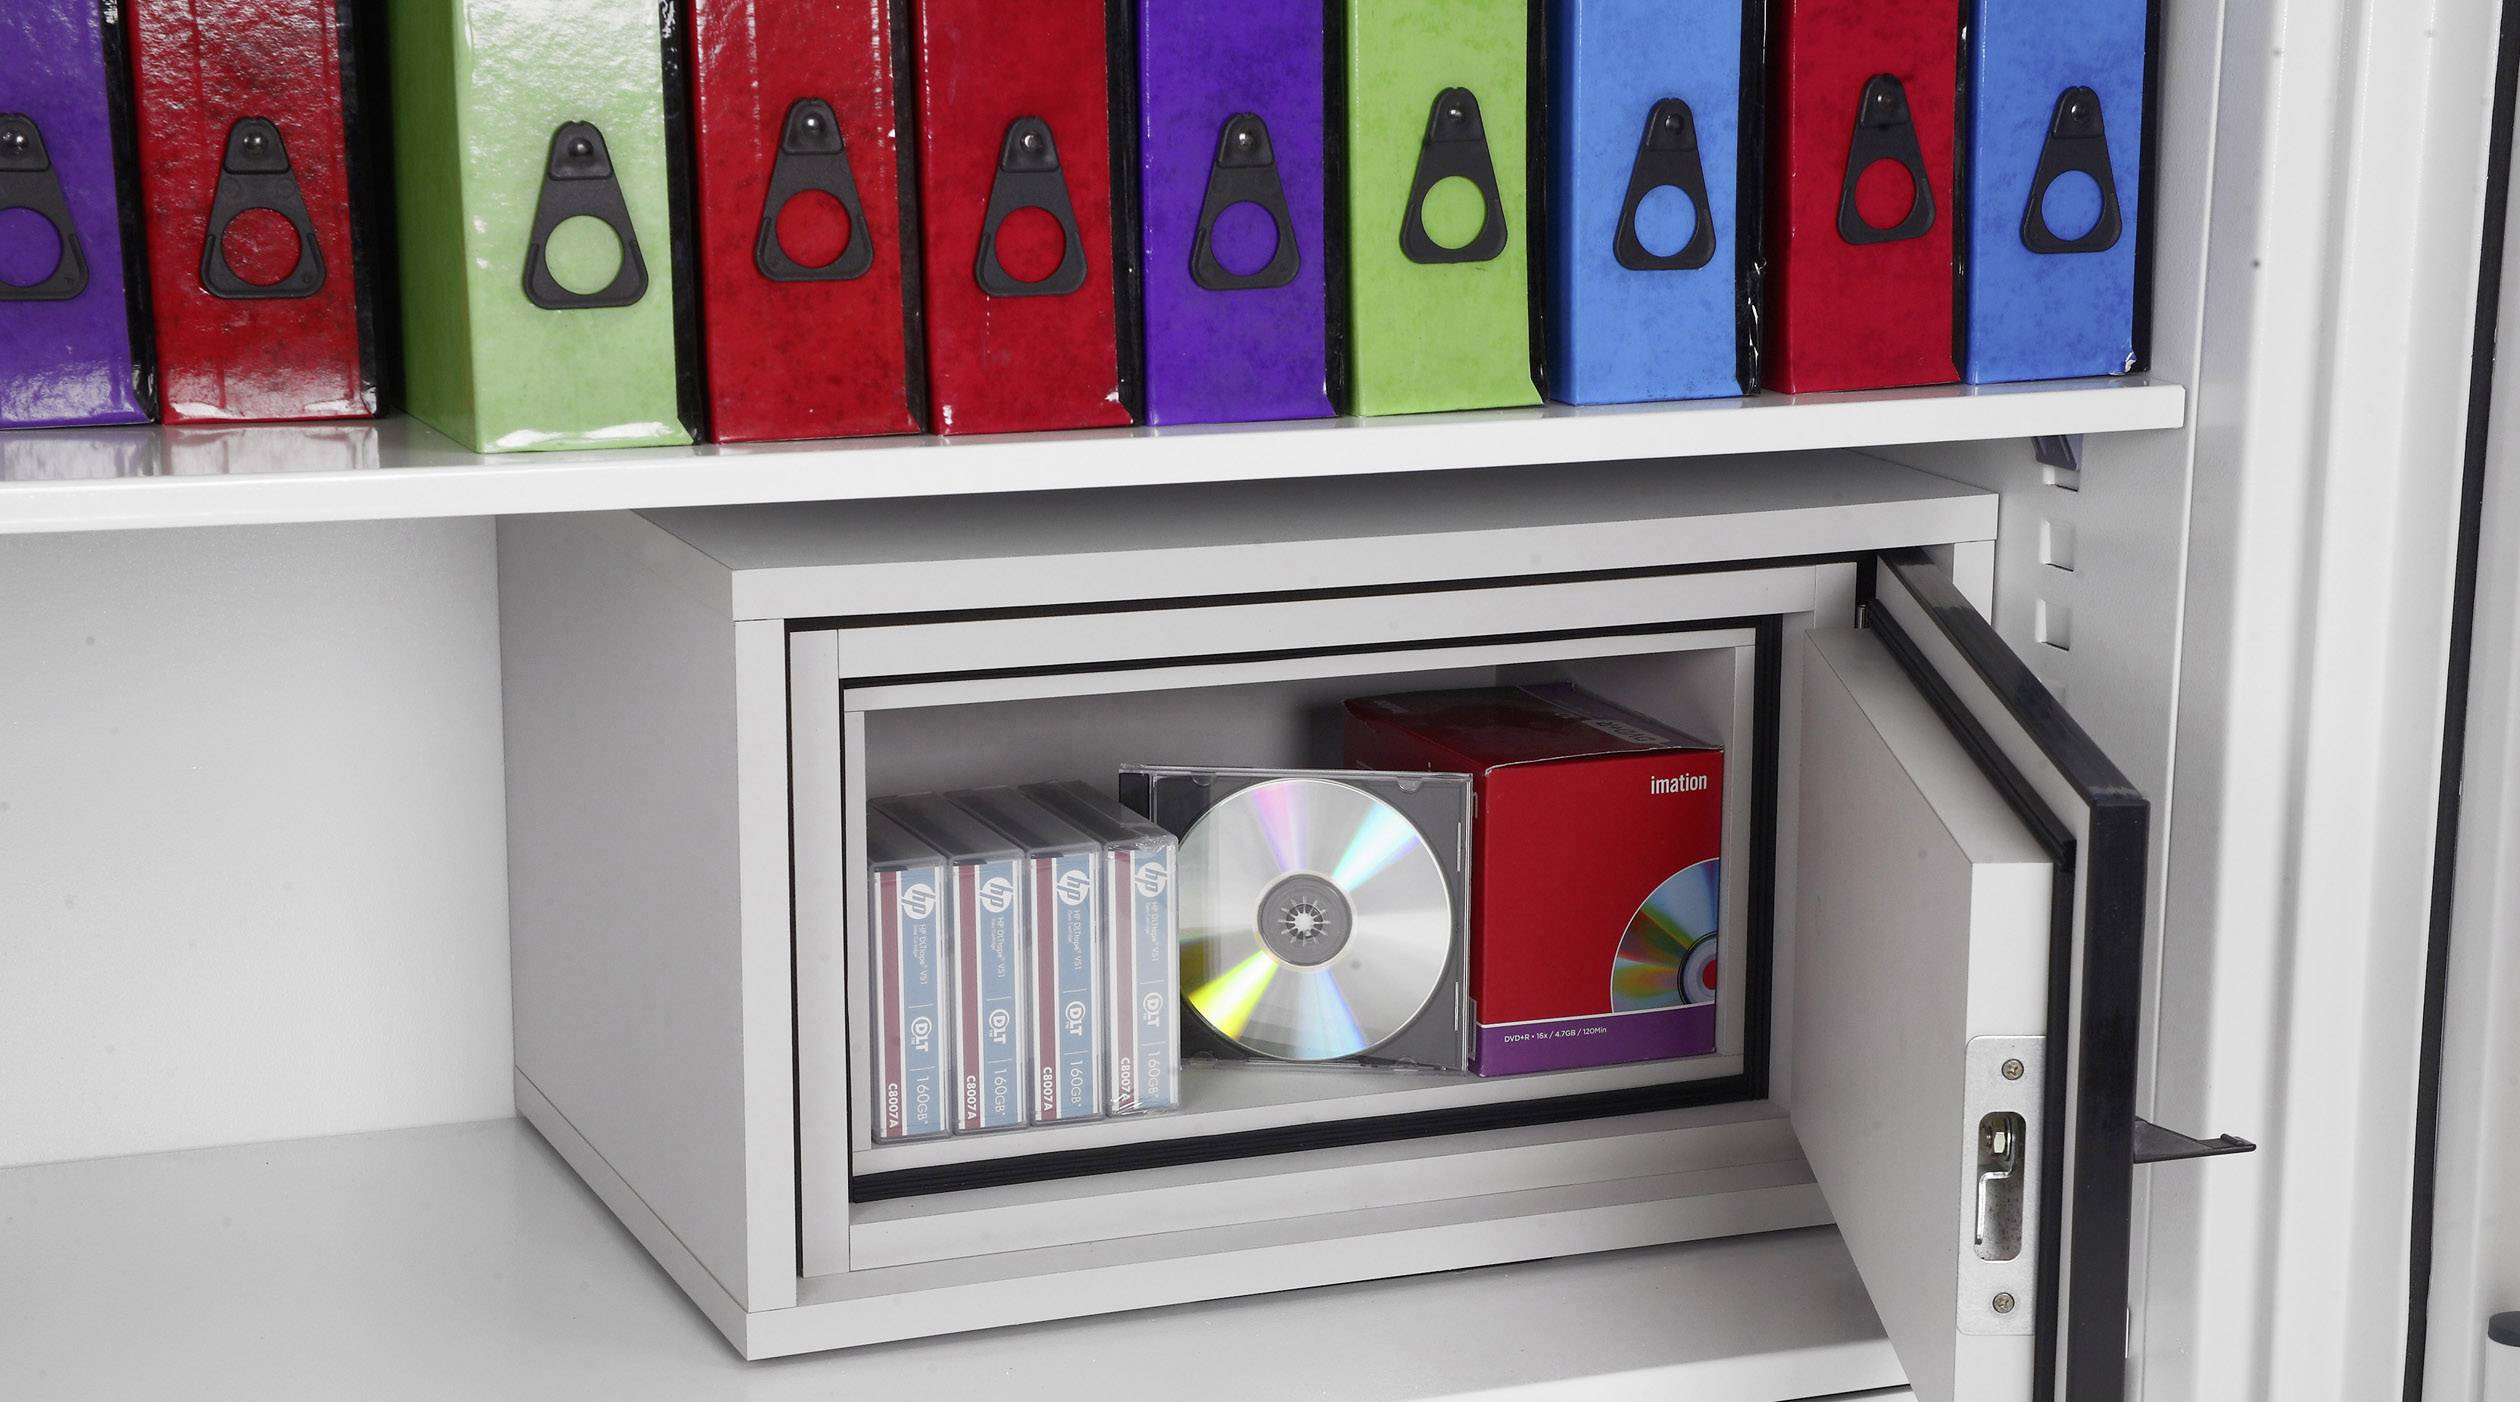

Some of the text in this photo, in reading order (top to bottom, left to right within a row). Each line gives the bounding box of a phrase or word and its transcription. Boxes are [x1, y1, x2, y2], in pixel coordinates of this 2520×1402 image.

[1651, 772, 1708, 794] imation
[980, 880, 1014, 910] hp
[1057, 873, 1090, 902] hp
[1135, 865, 1167, 894] hp
[901, 887, 936, 916] hp
[989, 1009, 1010, 1044] DLT
[1065, 1001, 1086, 1036] DLT
[1143, 992, 1163, 1027] DLT
[911, 1017, 932, 1052] DLT
[1504, 1034, 1530, 1043] DVD+R
[1537, 1032, 1547, 1040] 16x
[1583, 1027, 1607, 1035] 120Min
[1043, 1067, 1053, 1111] C8007A
[1121, 1057, 1131, 1101] C8007A
[888, 1083, 898, 1128] C8007A
[966, 1075, 977, 1119] C8007A
